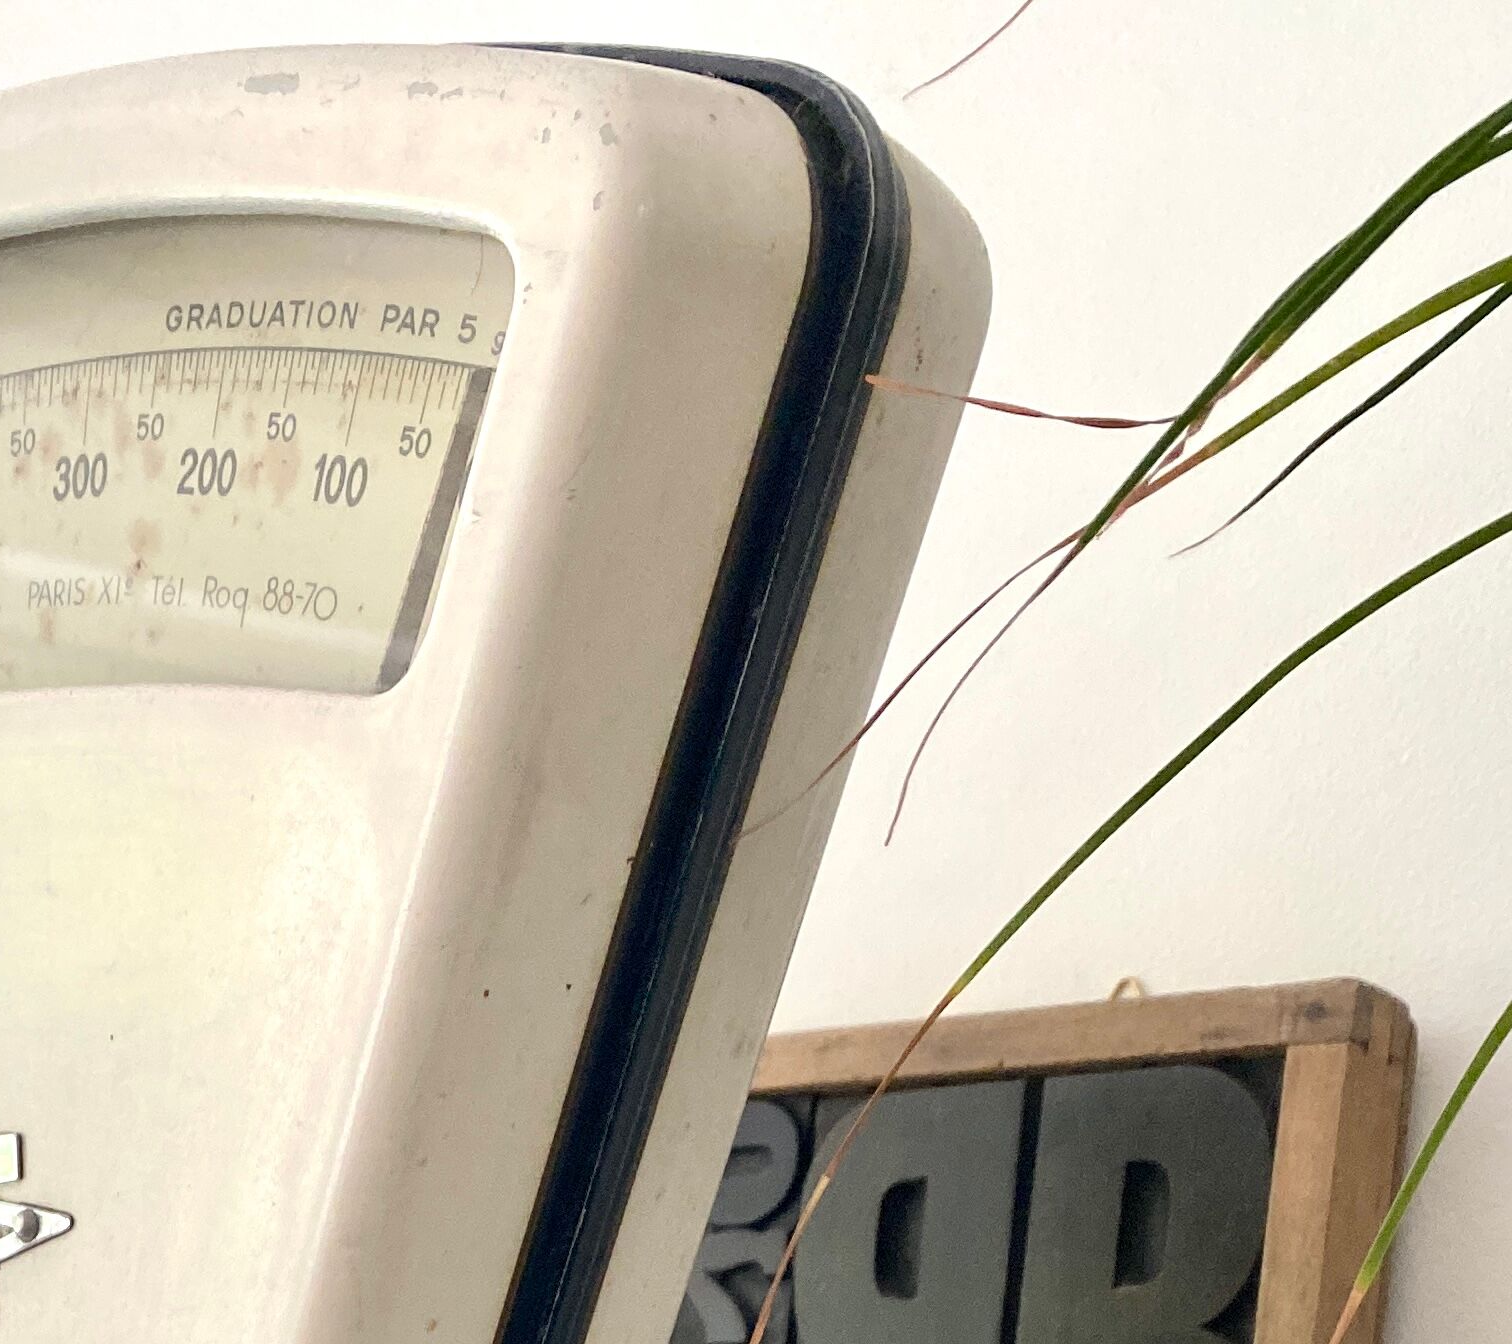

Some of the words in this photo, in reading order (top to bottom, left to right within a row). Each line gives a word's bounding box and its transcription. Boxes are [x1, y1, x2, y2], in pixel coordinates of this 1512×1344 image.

[165, 300, 359, 332] GRADUATION
[380, 303, 440, 338] PAR
[457, 313, 478, 344] 5
[10, 428, 36, 457] 50
[137, 413, 165, 441] 50
[266, 412, 297, 442] 50
[399, 425, 432, 459] 50
[53, 452, 108, 501] 300
[177, 448, 238, 497] 200
[313, 453, 369, 507] 100
[27, 577, 86, 609] PARIS
[201, 575, 249, 628] Roq
[262, 576, 338, 621] 88-70
